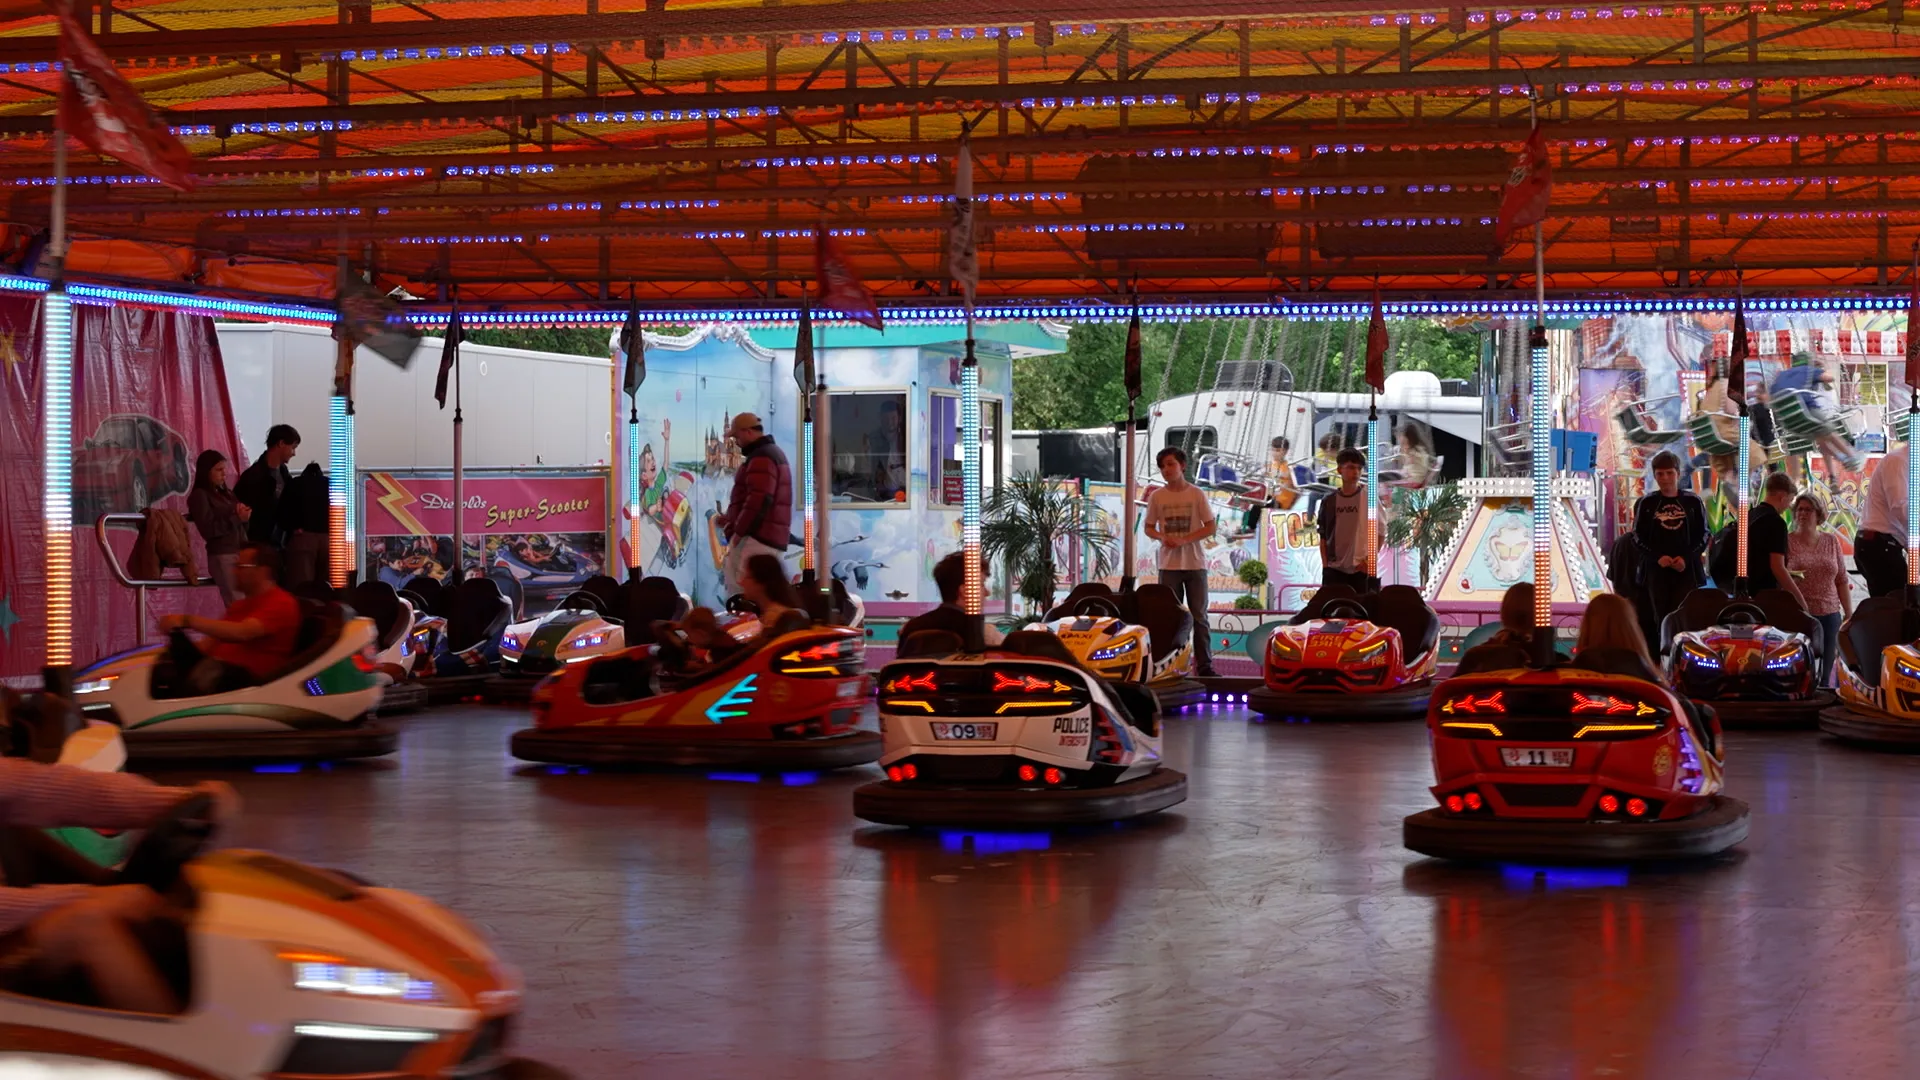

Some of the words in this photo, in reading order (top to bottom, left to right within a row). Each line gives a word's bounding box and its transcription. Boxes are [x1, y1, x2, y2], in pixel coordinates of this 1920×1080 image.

[420, 492, 487, 509] Dieolds
[485, 498, 590, 527] Super-Scooter
[1336, 505, 1358, 513] NASA
[952, 724, 976, 739] 09
[1052, 717, 1089, 733] POLICE
[1528, 750, 1546, 765] 11
